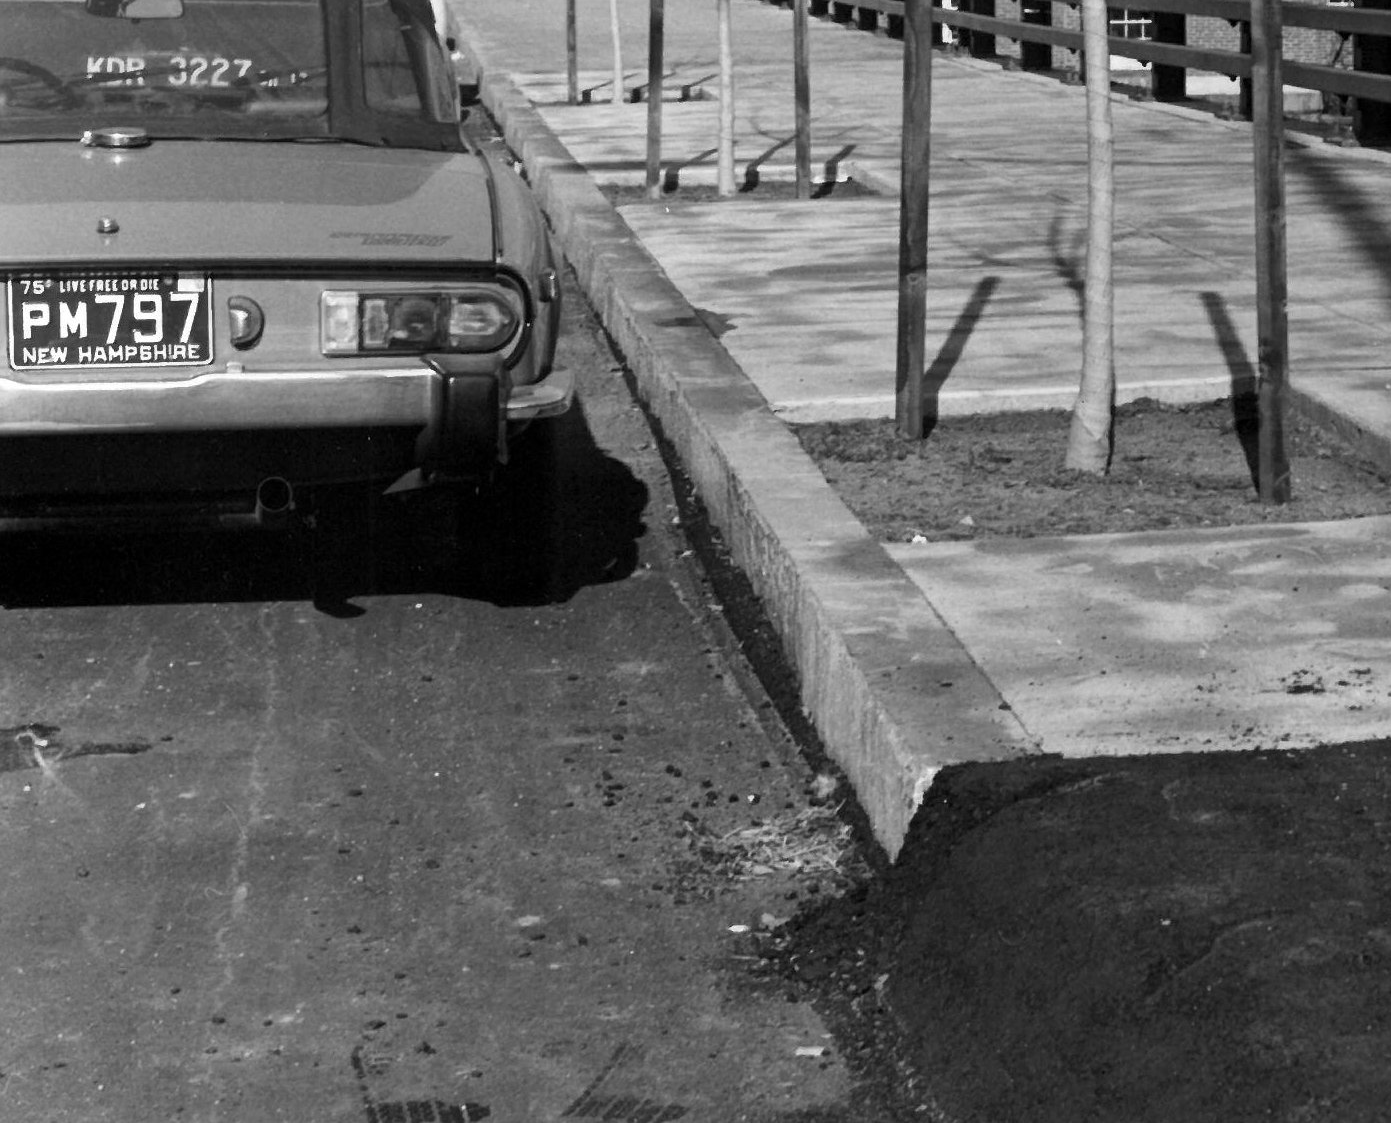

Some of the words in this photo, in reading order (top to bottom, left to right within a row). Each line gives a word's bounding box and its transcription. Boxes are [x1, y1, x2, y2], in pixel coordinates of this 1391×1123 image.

[168, 56, 252, 87] 3227
[59, 279, 87, 294] LIVE
[89, 279, 118, 293] FREE
[121, 278, 138, 292] OR
[140, 278, 160, 292] DIE
[22, 346, 68, 364] NEW
[78, 343, 201, 364] HAMPSHIRE
